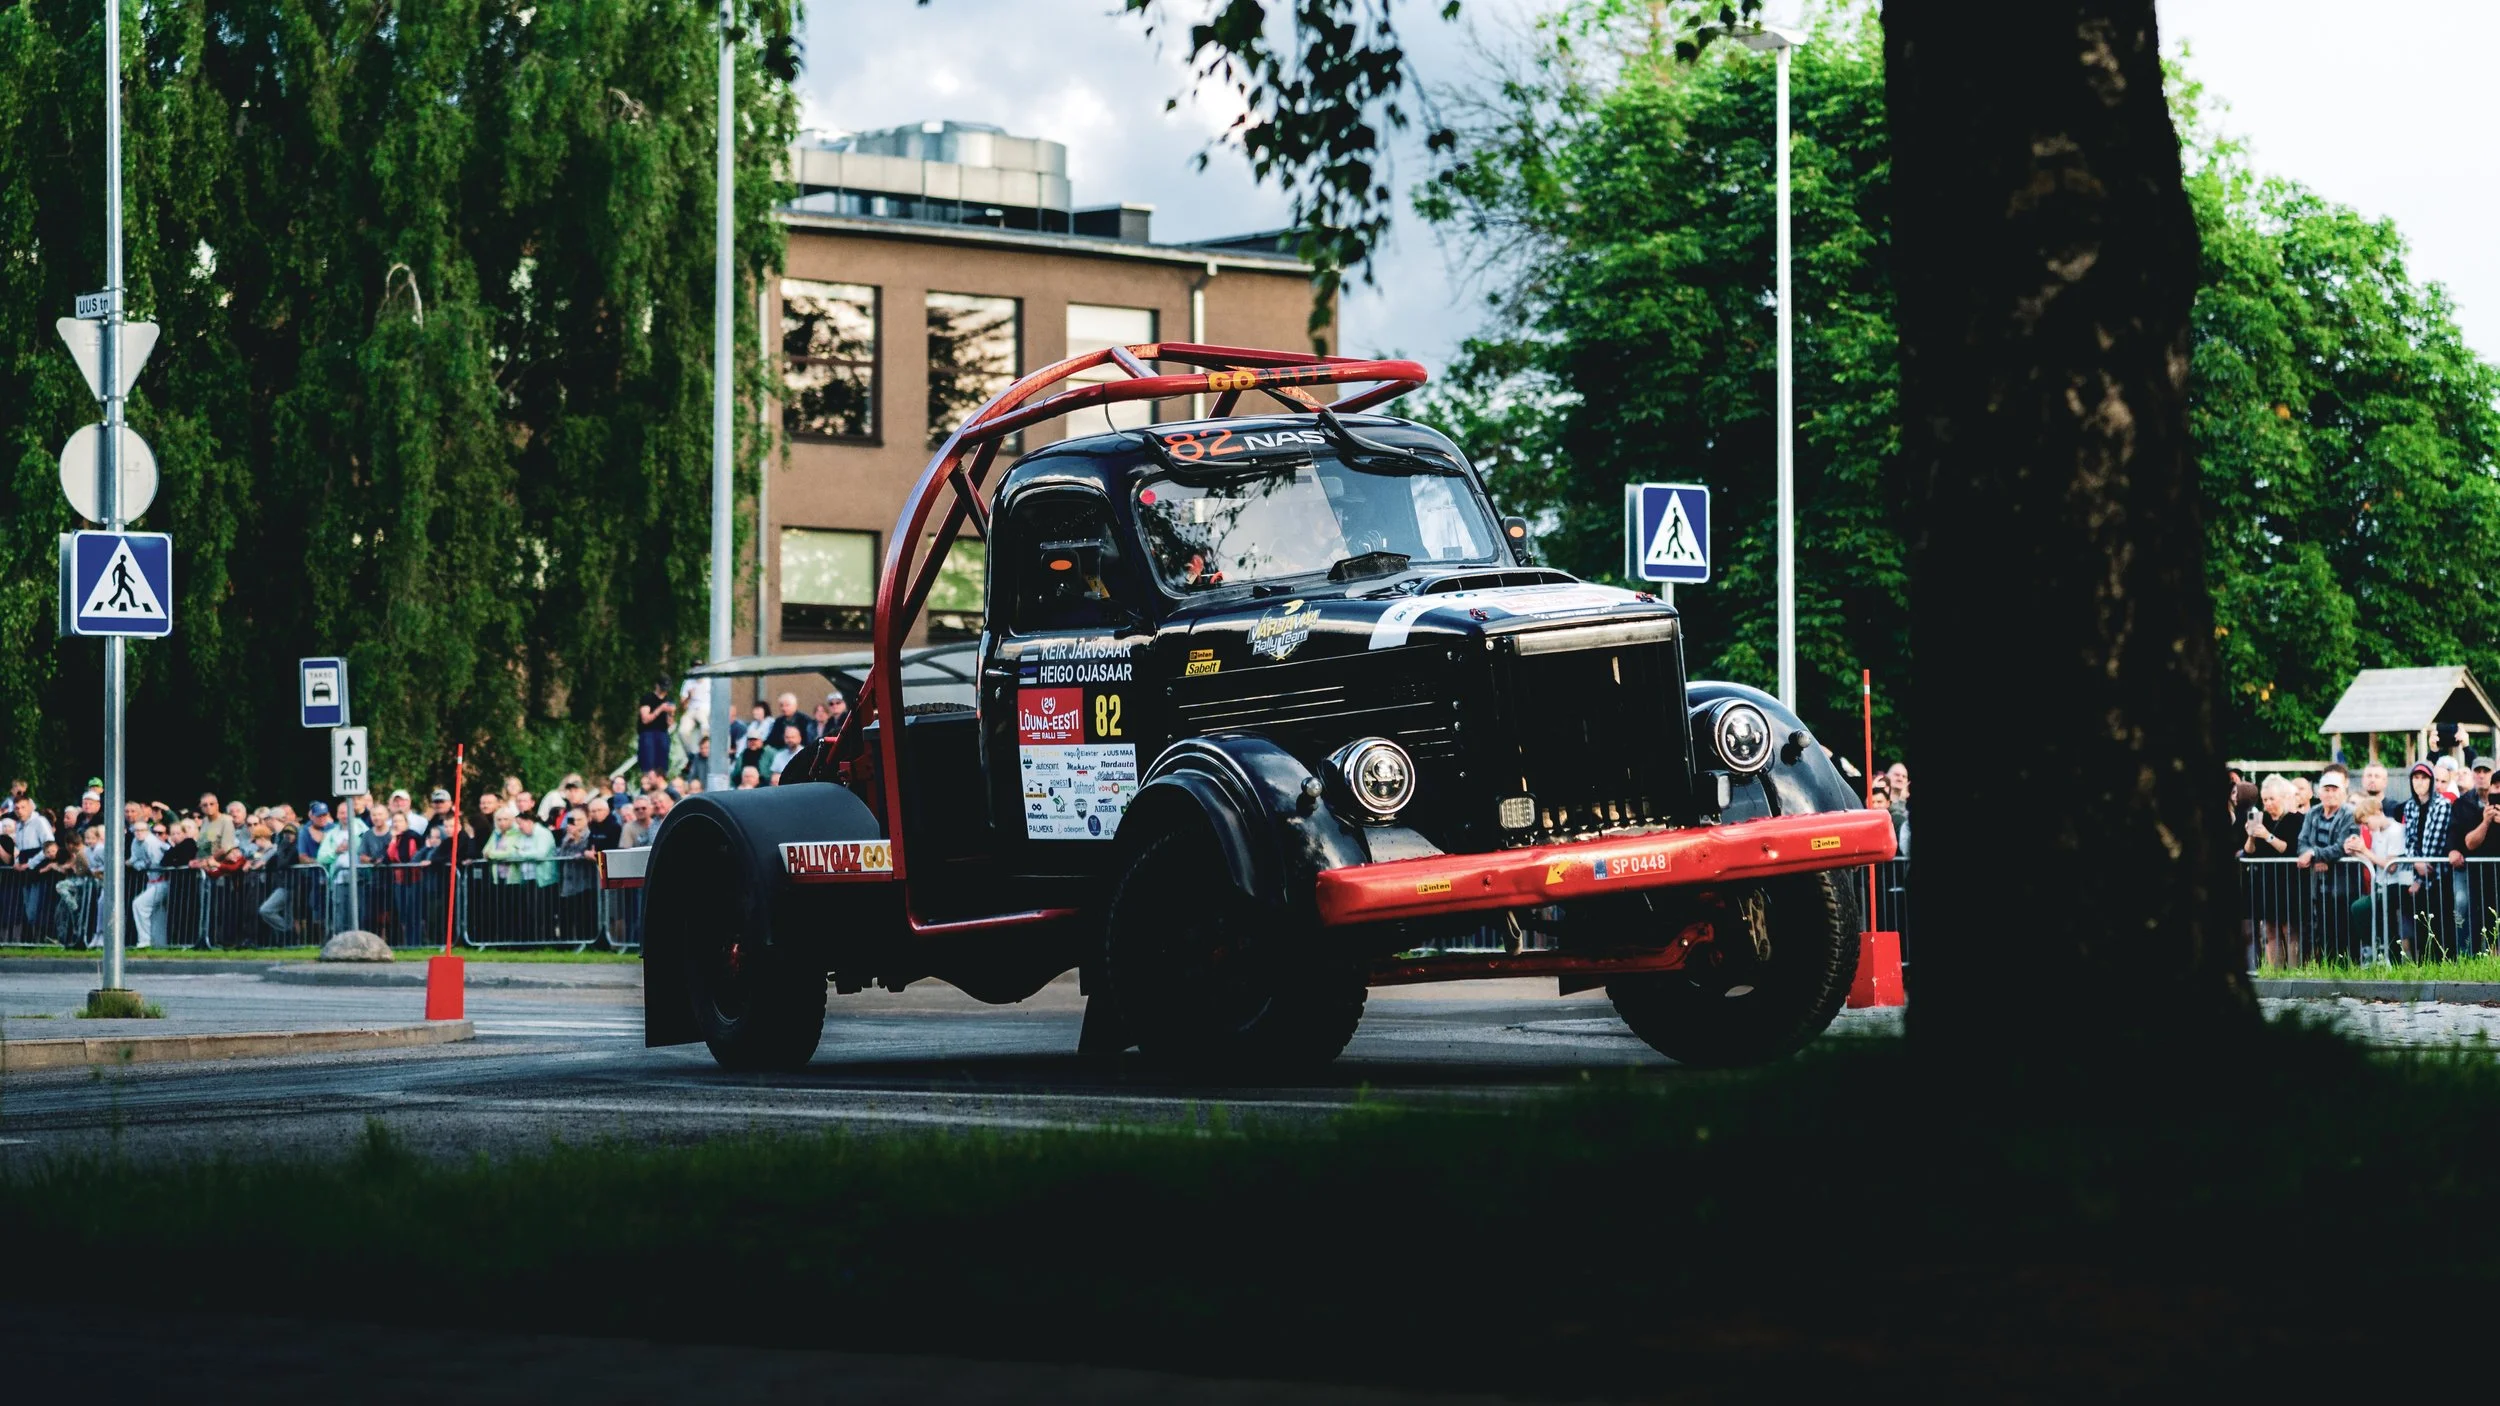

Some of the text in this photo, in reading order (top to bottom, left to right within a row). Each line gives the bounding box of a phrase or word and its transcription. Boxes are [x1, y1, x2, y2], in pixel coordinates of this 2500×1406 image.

[79, 297, 98, 314] UUS
[1164, 428, 1245, 461] 82
[1253, 629, 1308, 655] Rally Team
[1041, 642, 1067, 661] KEIR
[1040, 663, 1132, 683] HEIGO OJASAAR
[1188, 662, 1216, 674] Sabelt
[1095, 694, 1122, 737] 82
[1041, 732, 1056, 740] RALLI
[340, 761, 361, 776] 20
[343, 779, 358, 791] m
[1029, 825, 1053, 833] PALMEKS
[1612, 854, 1666, 875] SP 0448
